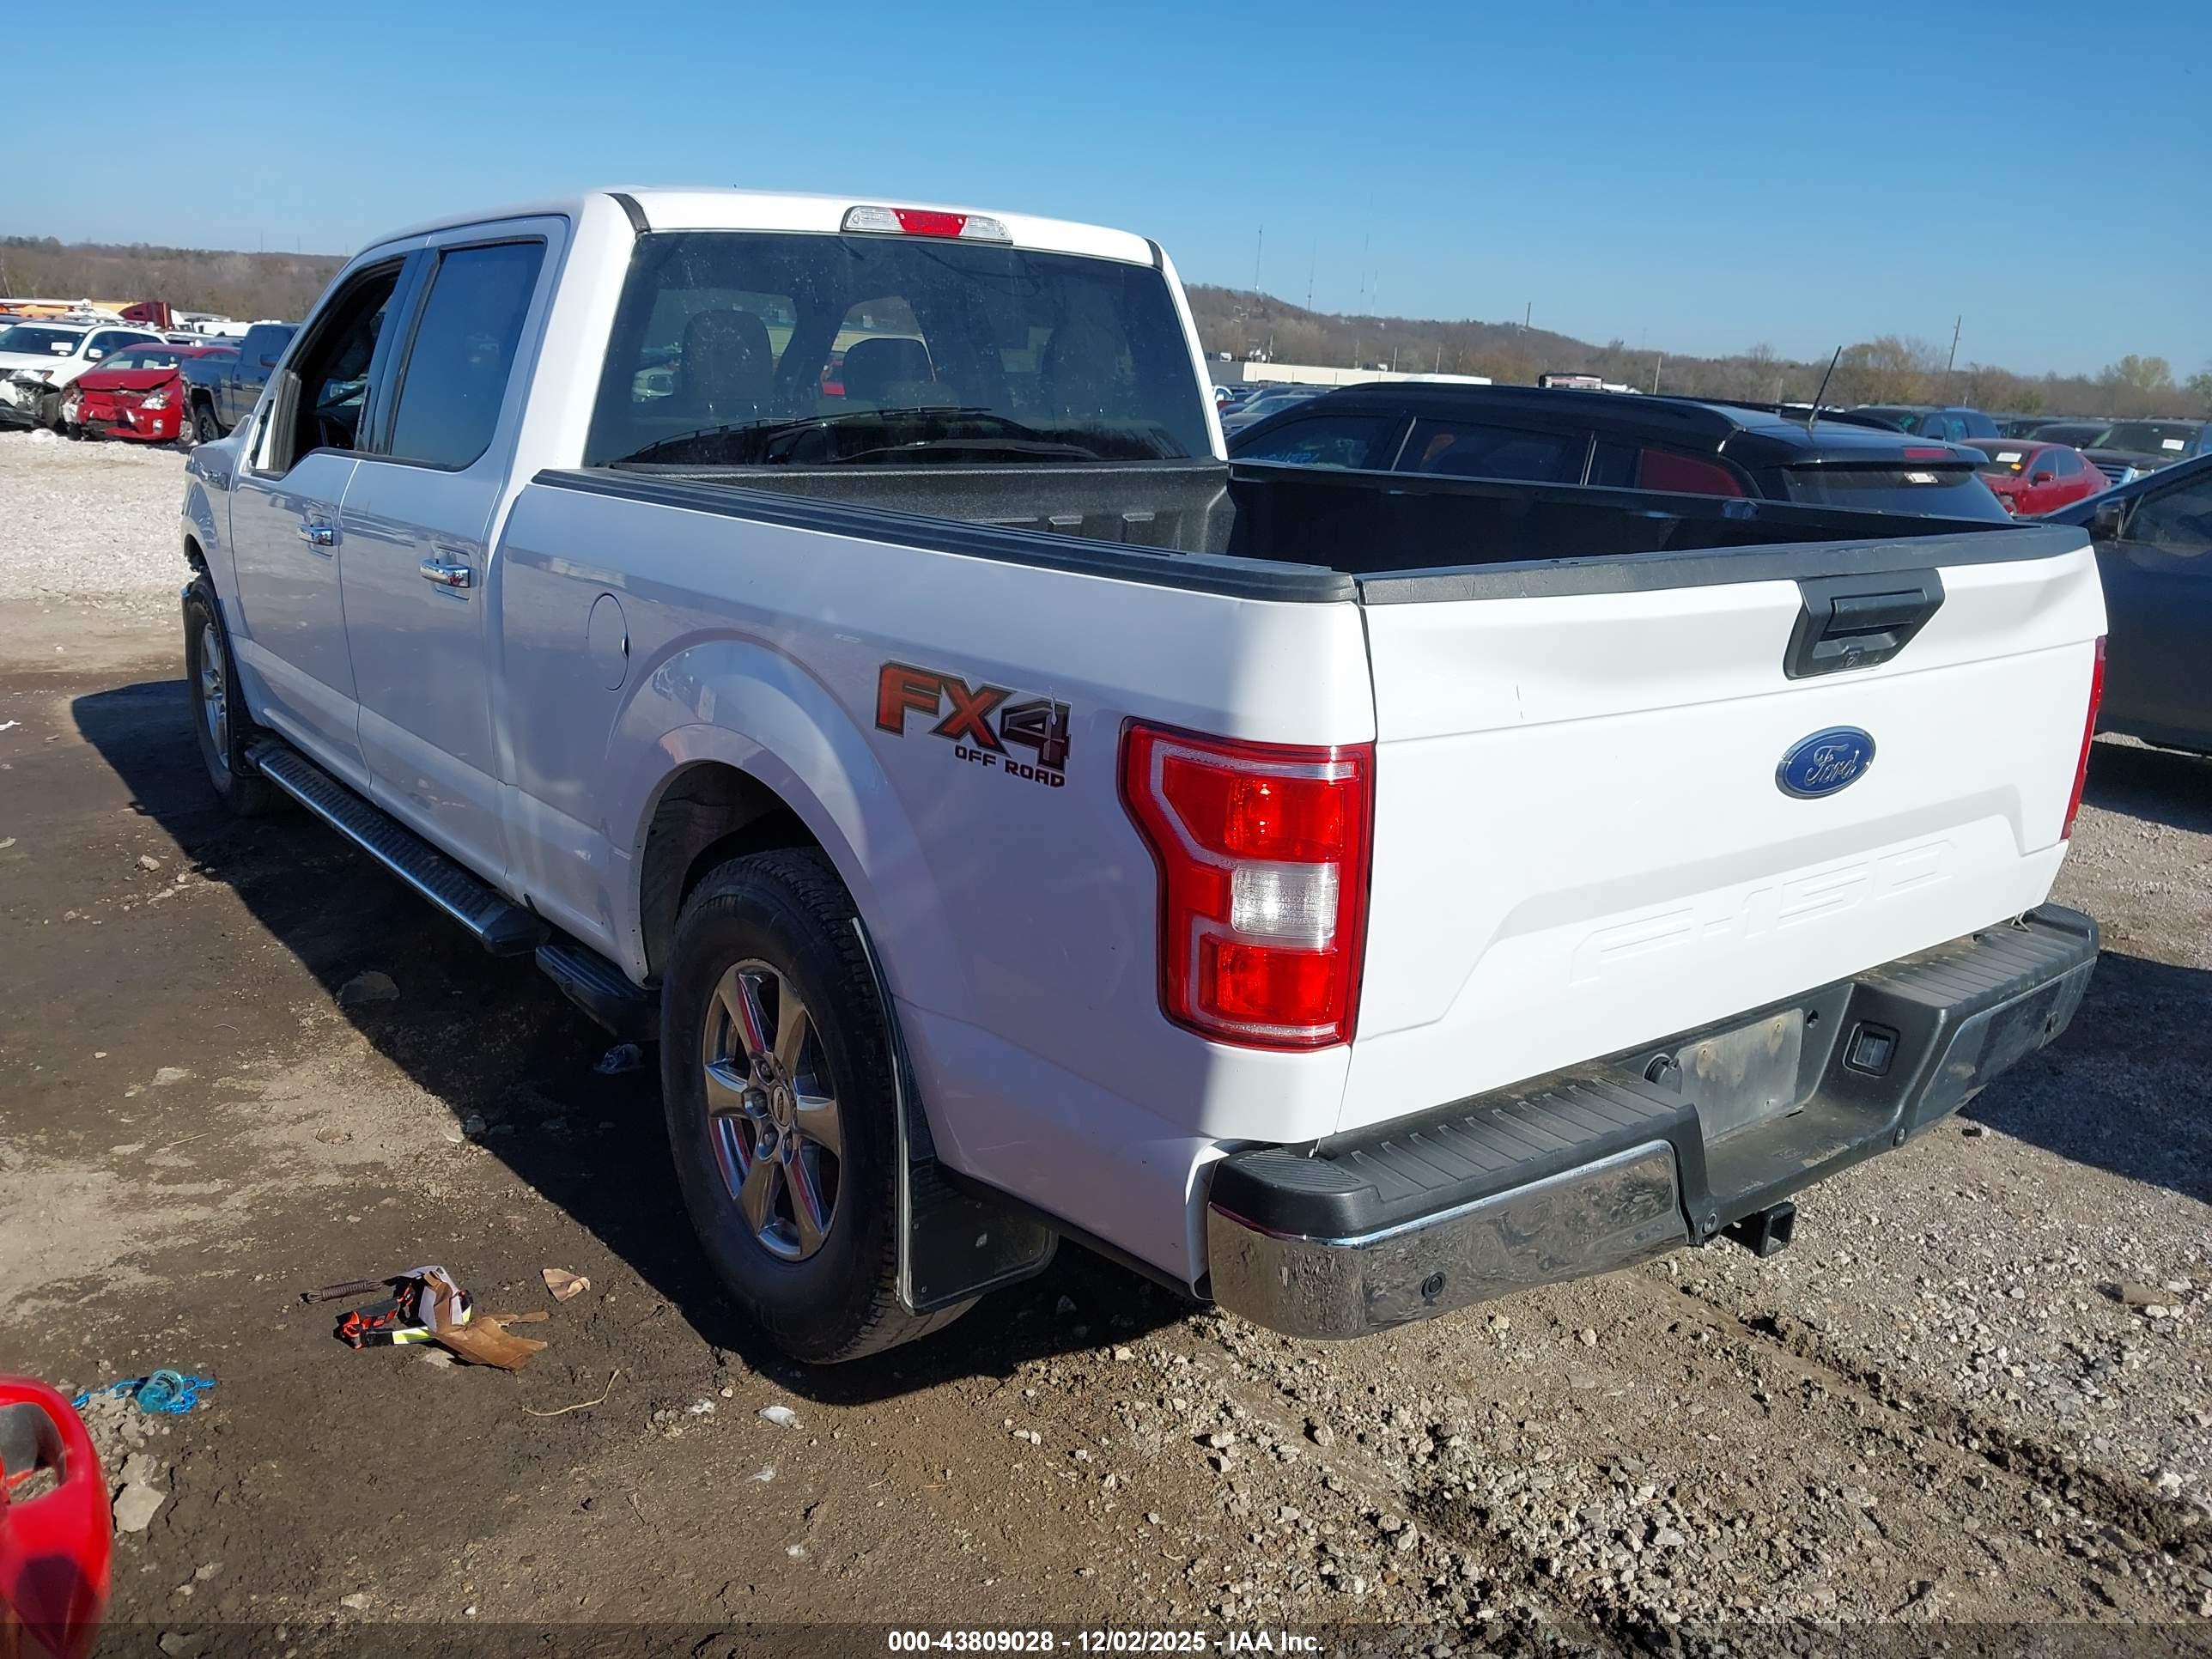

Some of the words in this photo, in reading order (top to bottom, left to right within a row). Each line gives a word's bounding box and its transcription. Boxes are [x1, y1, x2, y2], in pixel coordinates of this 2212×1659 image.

[875, 658, 1072, 773] FX4
[954, 744, 996, 767] OFF
[1005, 759, 1066, 787] ROAD
[1804, 743, 1859, 787] Ford
[1567, 838, 1958, 988] F-150
